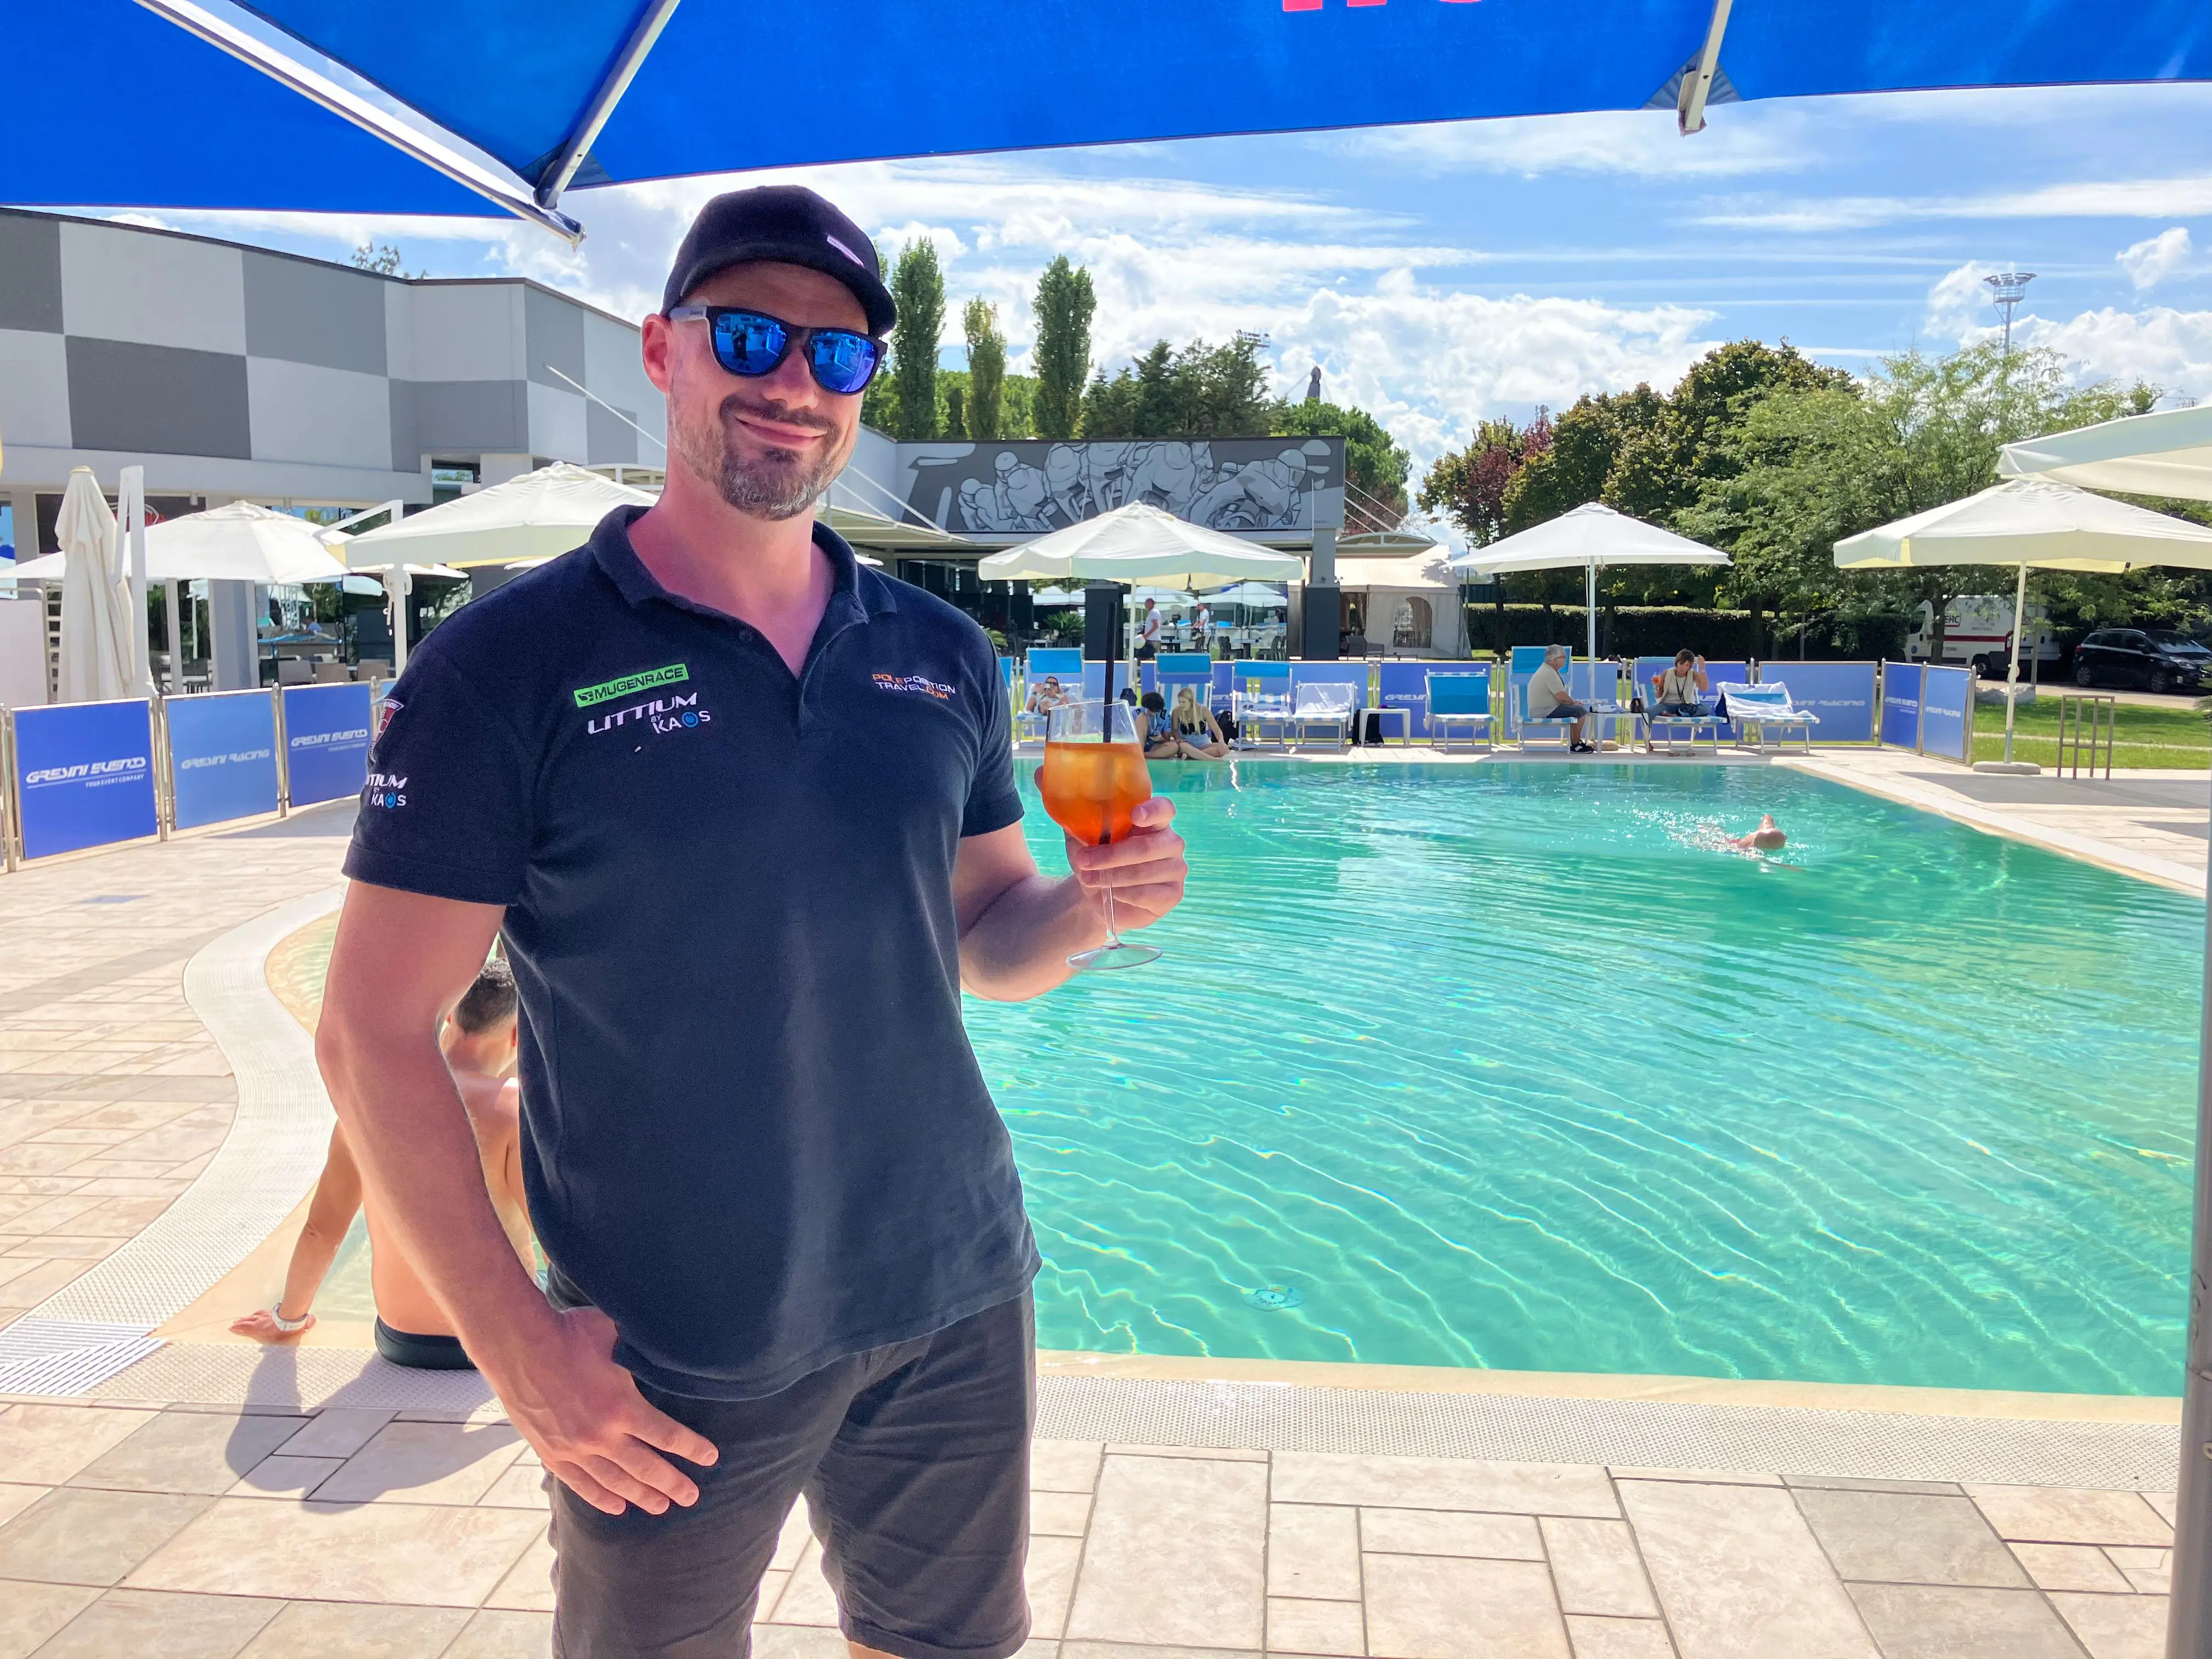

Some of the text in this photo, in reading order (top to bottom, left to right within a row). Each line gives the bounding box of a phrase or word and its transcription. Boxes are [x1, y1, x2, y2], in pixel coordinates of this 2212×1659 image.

[595, 667, 684, 700] MUGENRACE
[652, 710, 710, 734] KAOS
[291, 733, 331, 747] GRESINI
[26, 757, 146, 783] GRESINI EVENTS
[370, 791, 407, 809] KAOS
